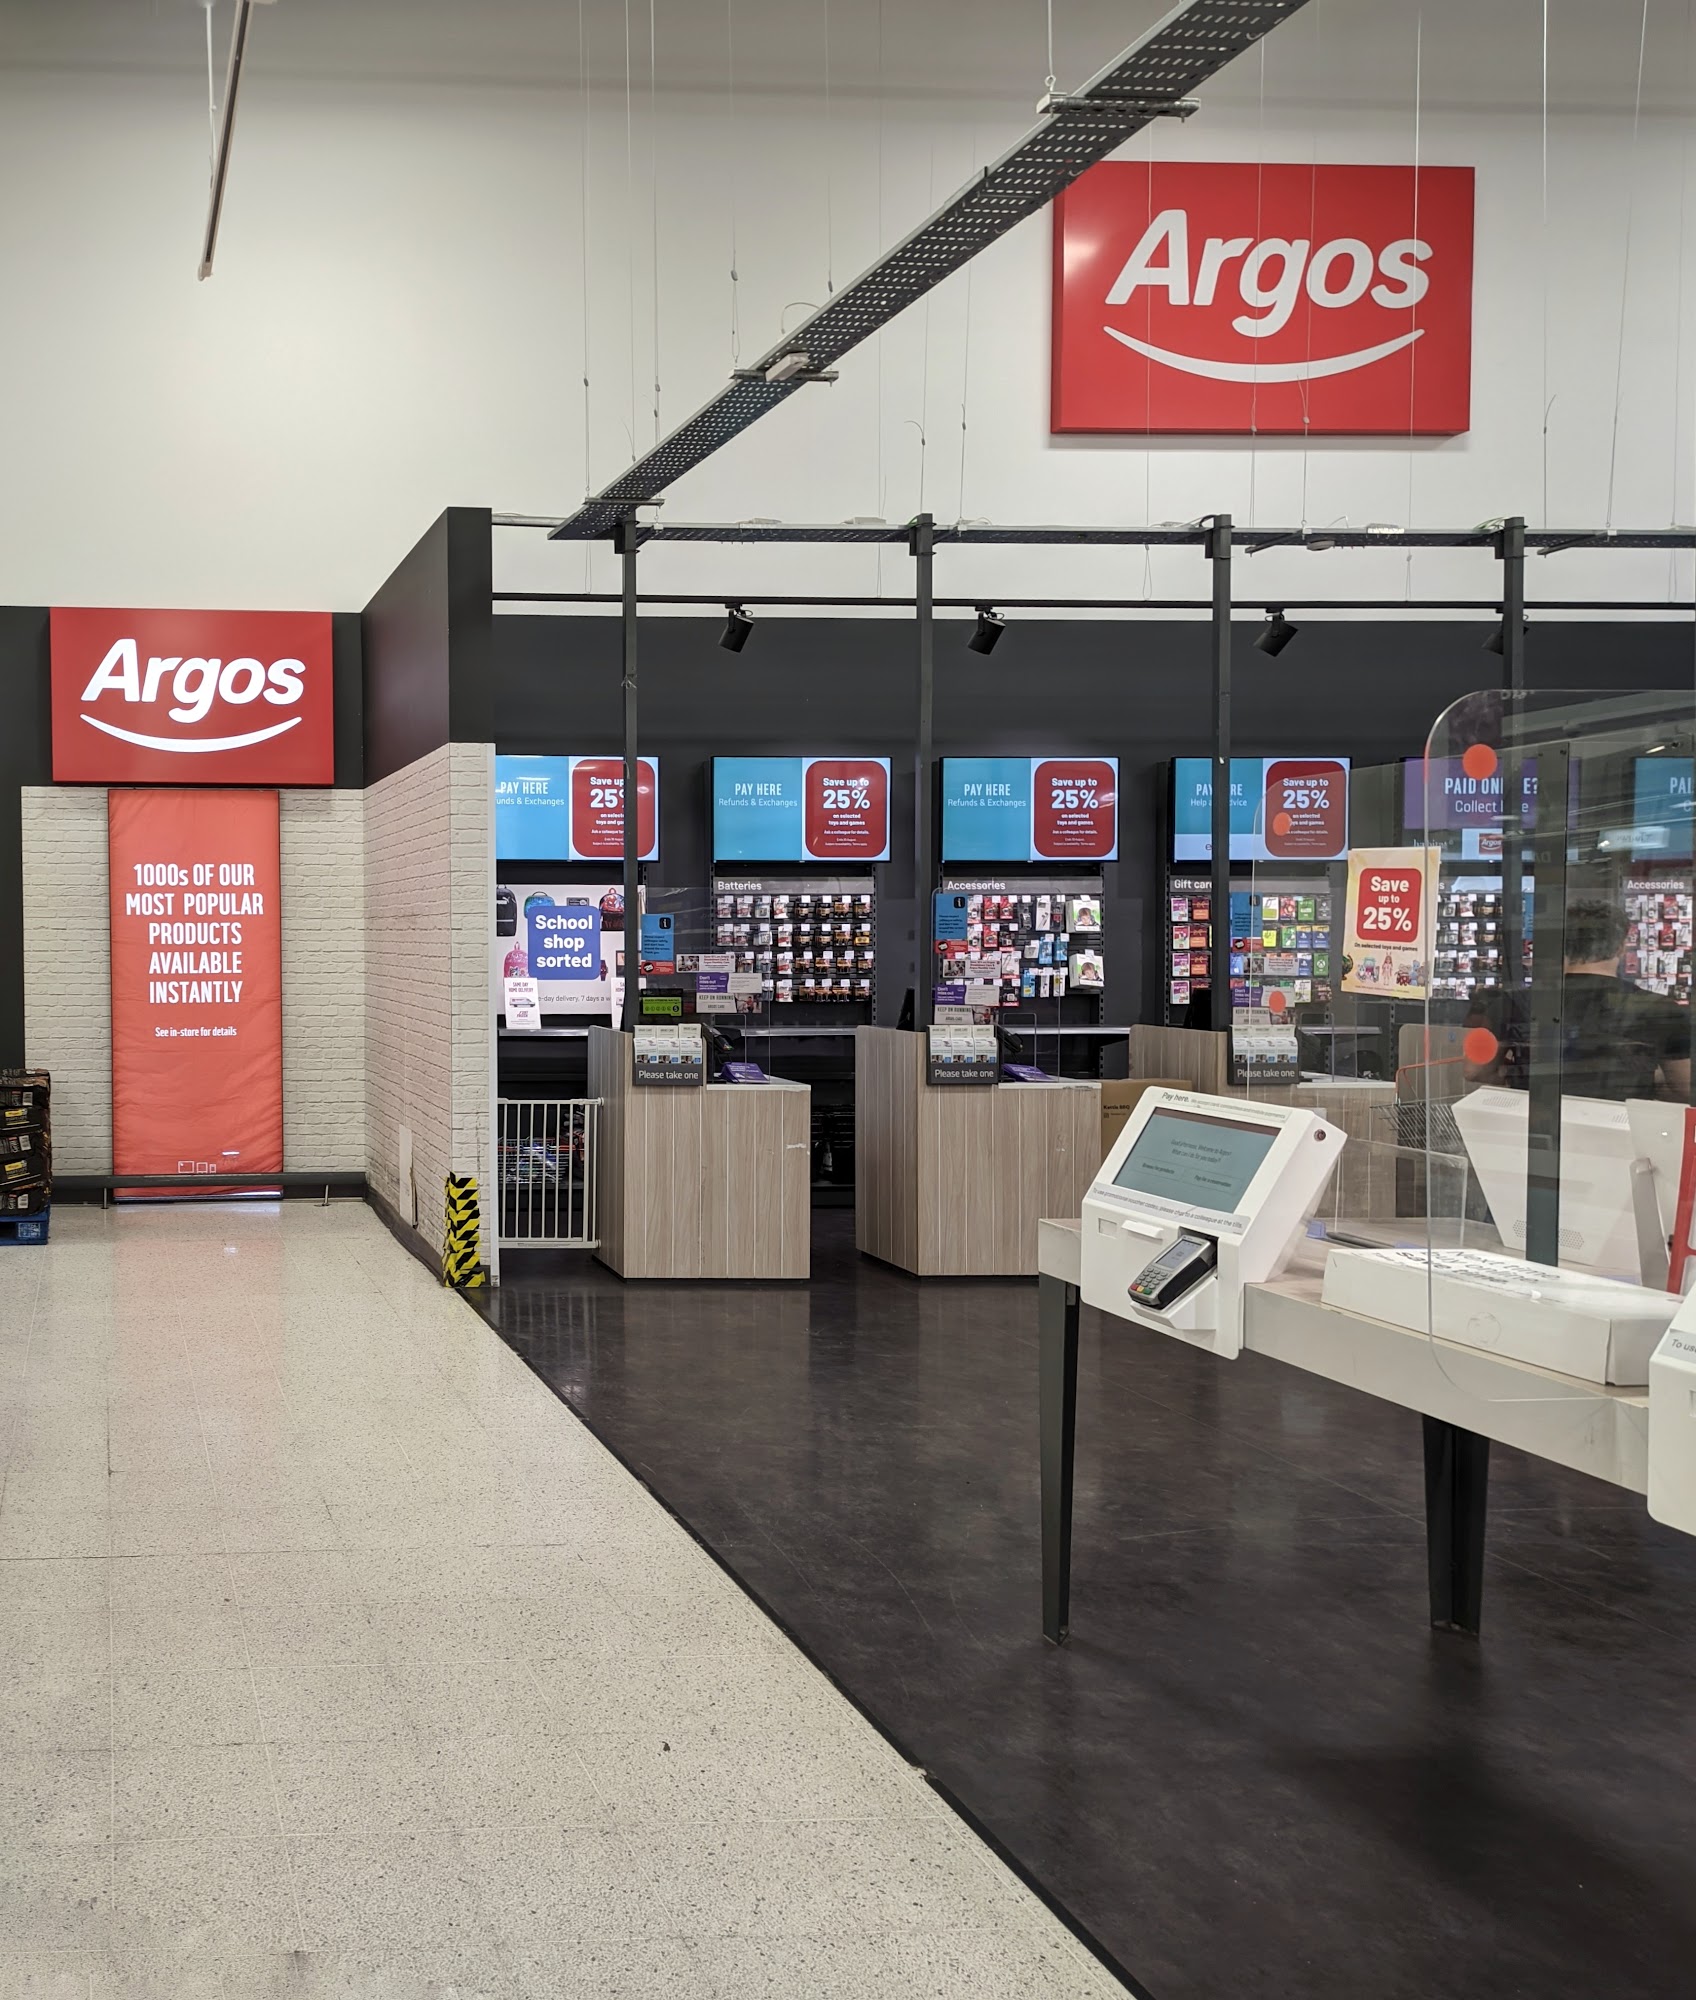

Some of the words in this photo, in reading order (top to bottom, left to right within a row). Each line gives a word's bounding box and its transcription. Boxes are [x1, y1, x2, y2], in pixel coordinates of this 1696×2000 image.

[1105, 209, 1433, 337] Argos
[81, 638, 306, 723] Argos
[590, 777, 612, 786] Save
[822, 778, 845, 786] Save
[846, 780, 856, 788] up
[858, 778, 870, 786] to
[1052, 778, 1074, 786] Save
[1075, 780, 1086, 788] up
[1088, 778, 1097, 786] to
[1283, 778, 1305, 786] Save
[1306, 780, 1317, 788] up
[1319, 778, 1329, 786] to
[1444, 777, 1476, 794] PAID
[500, 781, 519, 795] PAY
[522, 781, 548, 795] HERE
[734, 783, 754, 796] PAY
[756, 783, 782, 796] HERE
[964, 784, 982, 796] PAY
[986, 784, 1011, 796] HERE
[1196, 784, 1212, 796] PAY
[516, 797, 522, 805] &
[524, 797, 564, 807] Exchanges
[718, 798, 748, 806] Refunds
[750, 798, 757, 806] &
[758, 798, 798, 808] Exchanges
[822, 789, 870, 809] 25%
[948, 798, 978, 806] Refunds
[980, 798, 986, 806] &
[988, 798, 1026, 808] Exchanges
[1052, 789, 1099, 809] 25%
[1190, 798, 1207, 808] Help
[1282, 789, 1330, 809] 25%
[1455, 800, 1496, 813] Collect
[1481, 838, 1502, 847] Argos
[133, 864, 188, 886] 1000s
[193, 864, 214, 886] OF
[219, 864, 254, 886] OUR
[718, 881, 762, 890] Batteries
[947, 881, 1006, 890] Accessories
[1174, 880, 1192, 889] Gift
[1370, 876, 1409, 892] Save
[1627, 880, 1684, 890] Accessories
[126, 893, 174, 916] MOST
[184, 893, 264, 915] POPULAR
[1378, 894, 1389, 904] up
[1391, 894, 1400, 903] to
[535, 914, 593, 930] School
[1362, 906, 1412, 932] 25%
[149, 922, 242, 944] PRODUCTS
[544, 934, 585, 951] shop
[149, 952, 242, 974] AVAILABLE
[536, 953, 592, 968] sorted
[149, 981, 243, 1003] INSTANTLY
[155, 1027, 169, 1037] See
[170, 1026, 199, 1037] in-store
[200, 1026, 211, 1036] for
[212, 1026, 237, 1036] details
[638, 1070, 664, 1079] Please
[666, 1070, 682, 1079] take
[934, 1069, 960, 1078] Please
[962, 1069, 979, 1078] take
[1263, 1068, 1280, 1077] take
[1162, 1092, 1173, 1103] Pay
[1174, 1094, 1190, 1103] here.
[1104, 1192, 1128, 1201] promotional
[1194, 1215, 1217, 1223] colleague
[1503, 1265, 1561, 1280] time
[1672, 1338, 1682, 1348] To
